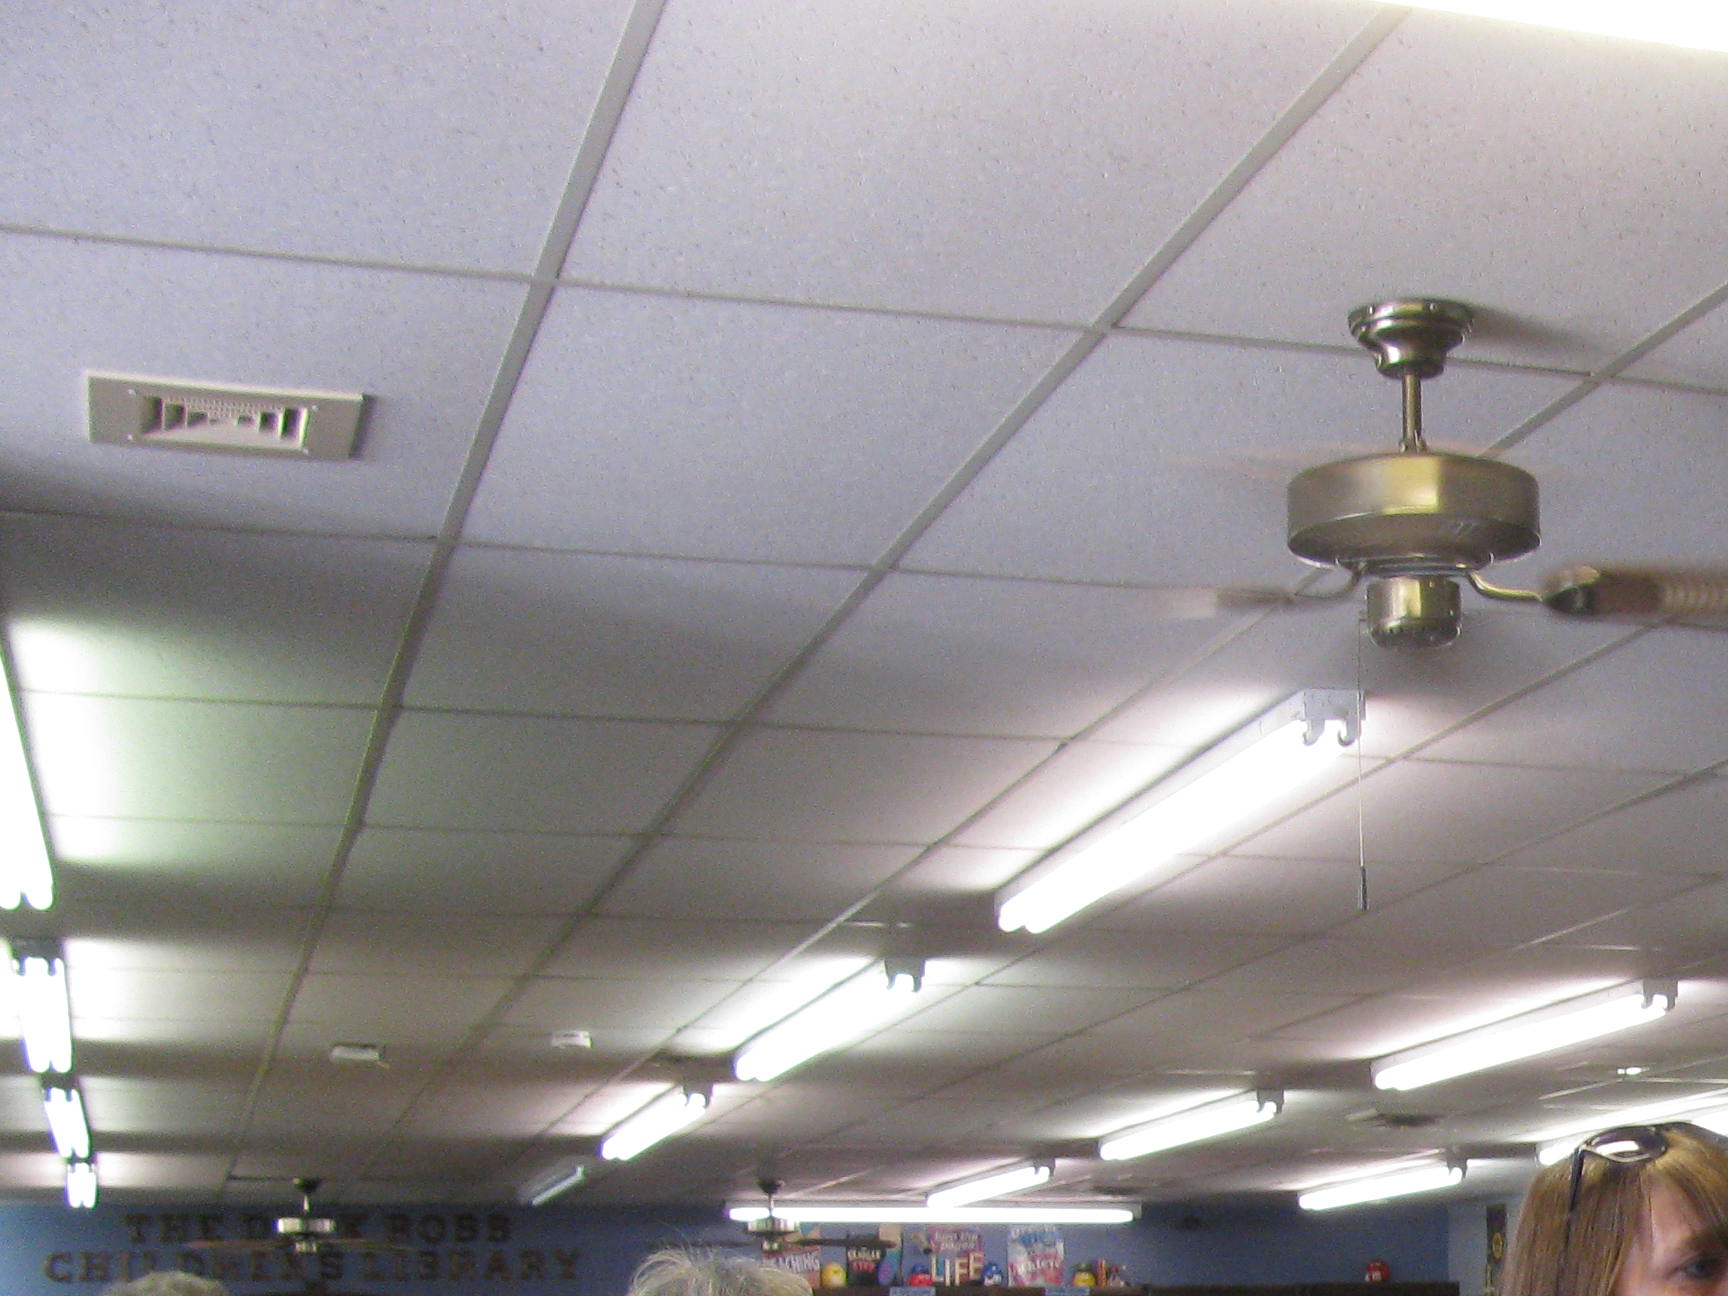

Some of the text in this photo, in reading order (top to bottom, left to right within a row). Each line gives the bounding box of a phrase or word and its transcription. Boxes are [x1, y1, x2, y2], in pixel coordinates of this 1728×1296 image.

[125, 1212, 511, 1243] THE DK ROSS
[363, 1249, 579, 1282] LIBRARY
[931, 1252, 984, 1286] LIFE
